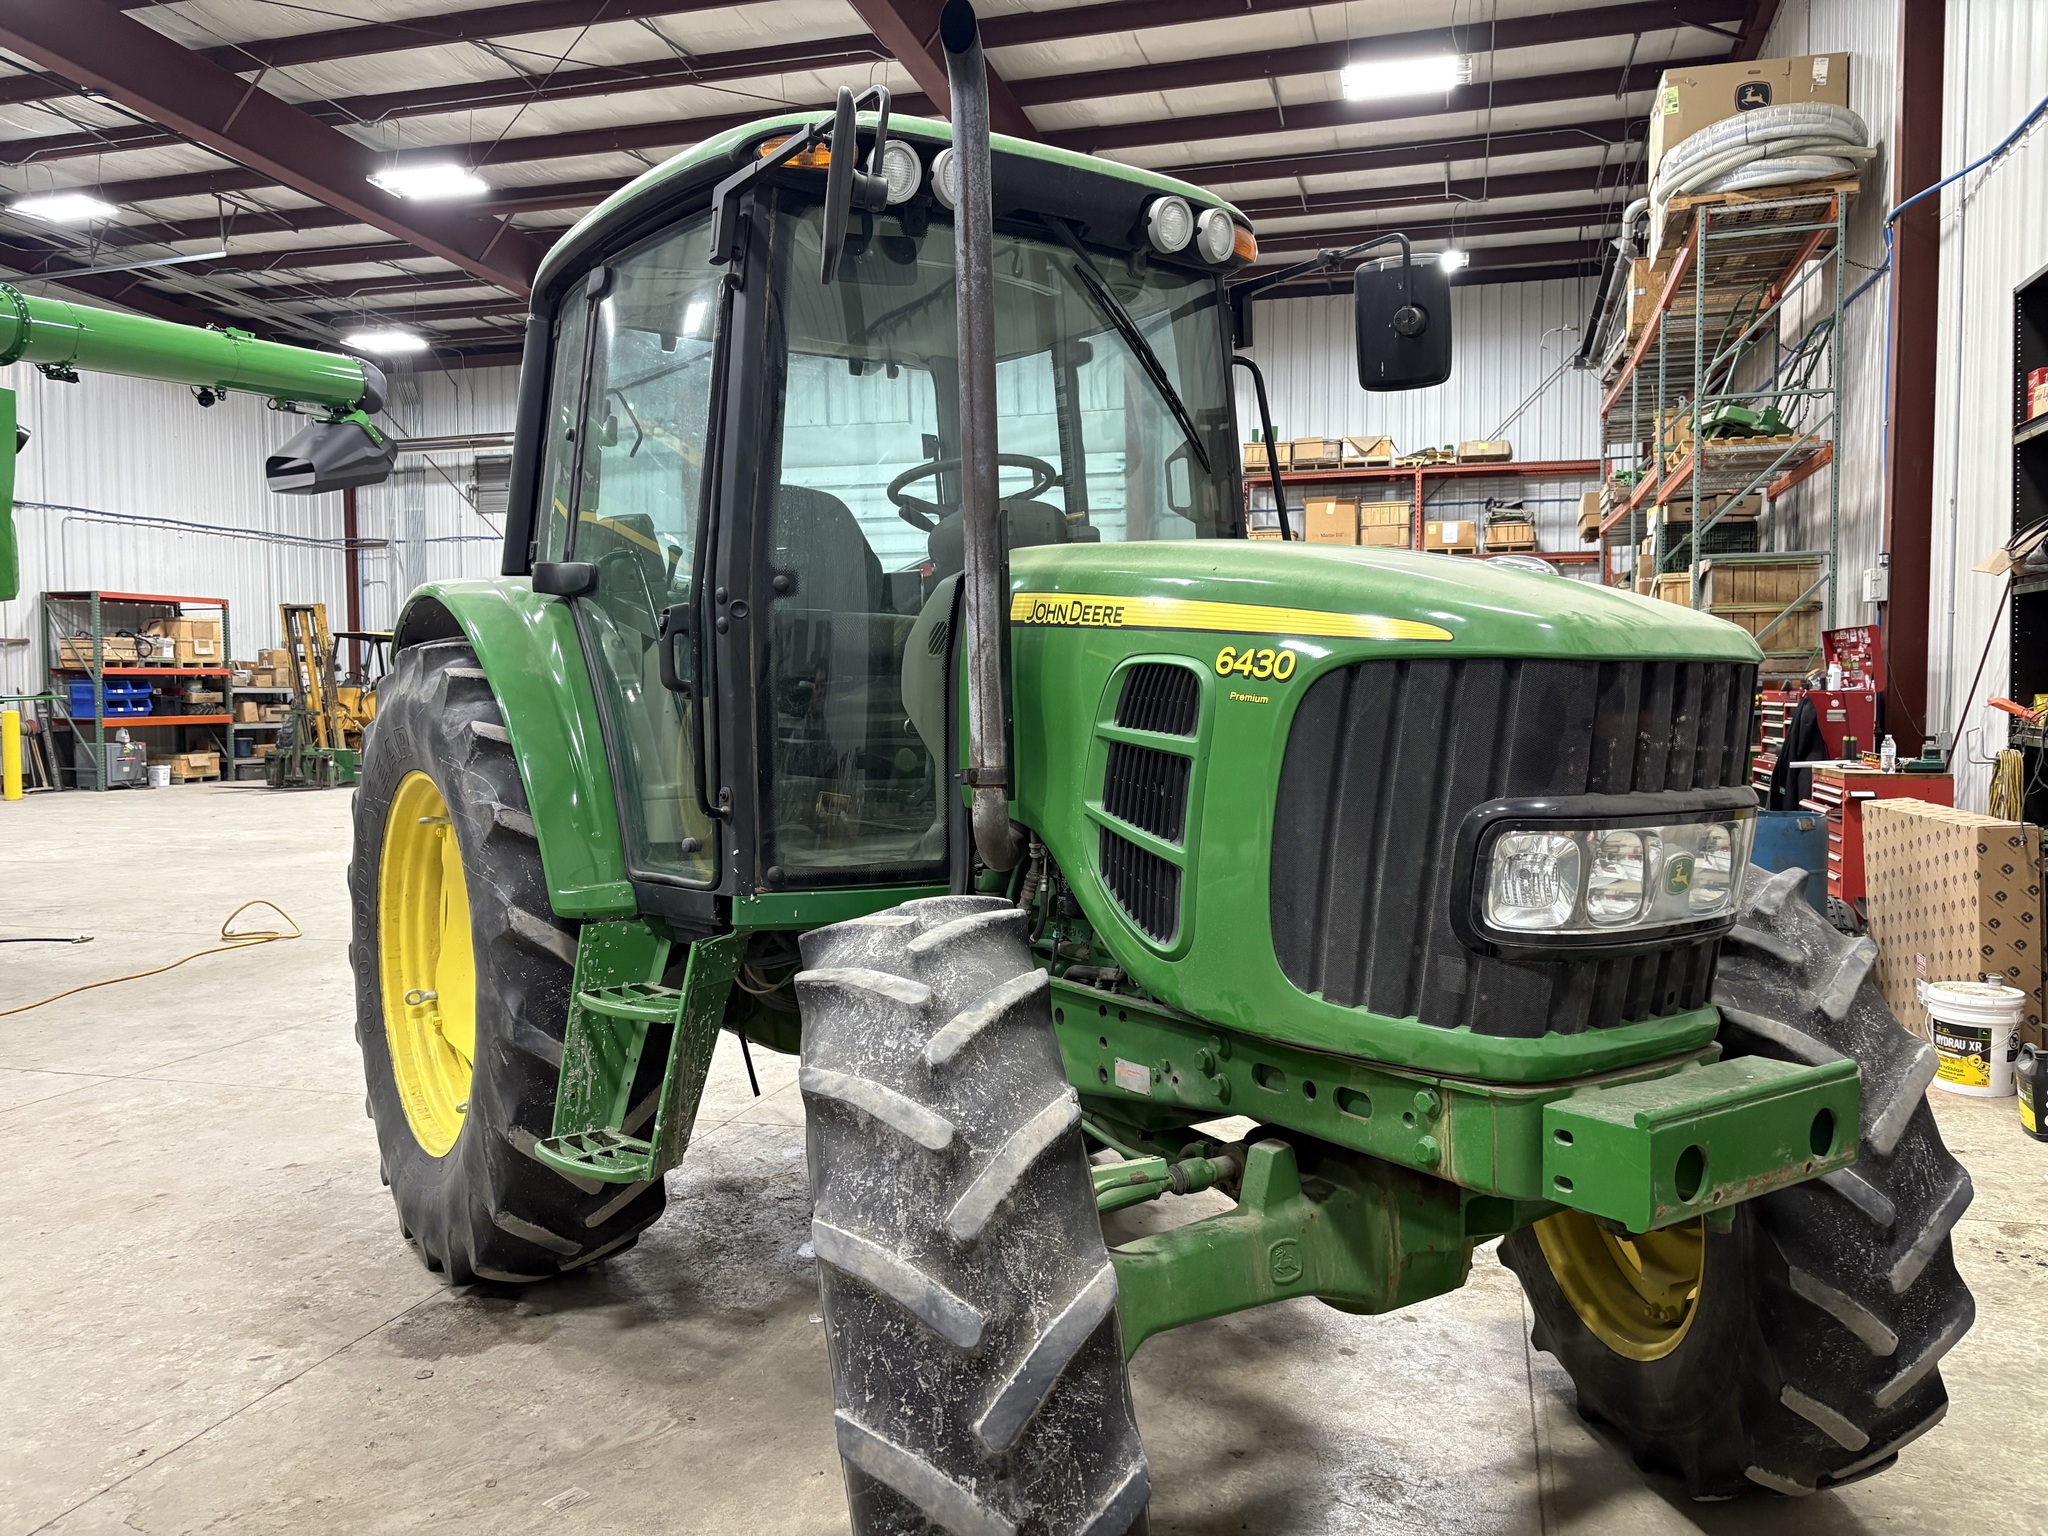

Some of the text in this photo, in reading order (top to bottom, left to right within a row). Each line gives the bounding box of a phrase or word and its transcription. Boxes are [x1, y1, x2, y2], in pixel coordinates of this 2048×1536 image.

[1026, 599, 1125, 624] JOHN DEERE
[1215, 646, 1297, 683] 6430
[1229, 691, 1269, 704] Premium
[1935, 1033, 1966, 1050] HYDRAU
[1968, 1040, 1983, 1052] XR
